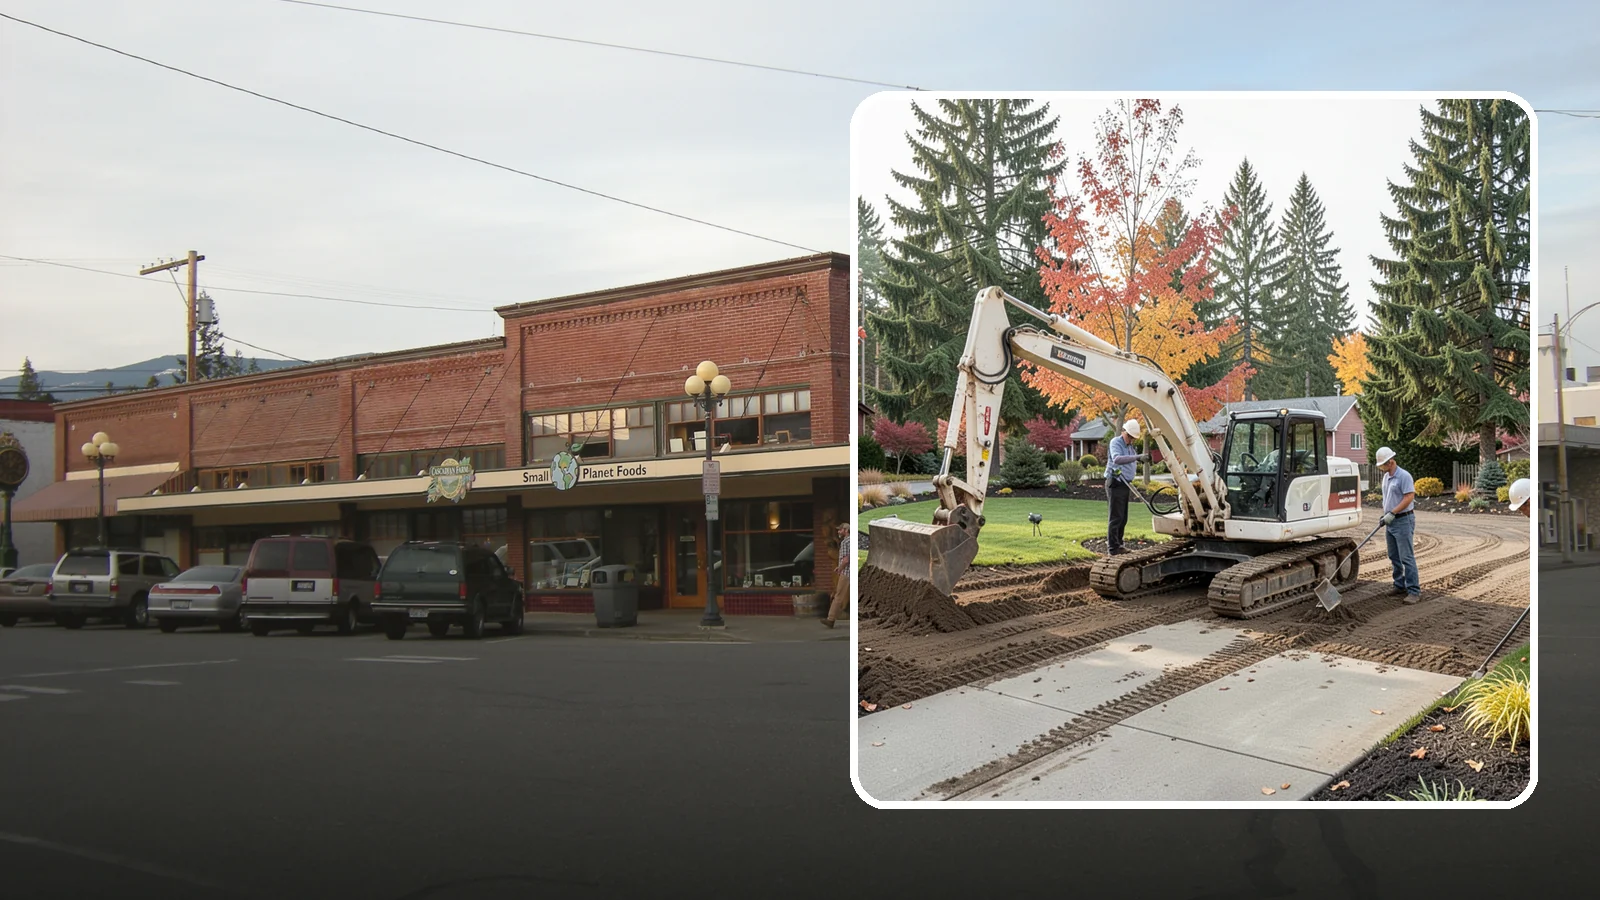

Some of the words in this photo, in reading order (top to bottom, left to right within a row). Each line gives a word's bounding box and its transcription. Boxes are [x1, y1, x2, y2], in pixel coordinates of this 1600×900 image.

[431, 466, 455, 476] CASCADIAN
[455, 466, 469, 475] FARM
[523, 471, 549, 483] Small
[583, 467, 614, 479] Planet
[617, 464, 647, 477] Foods
